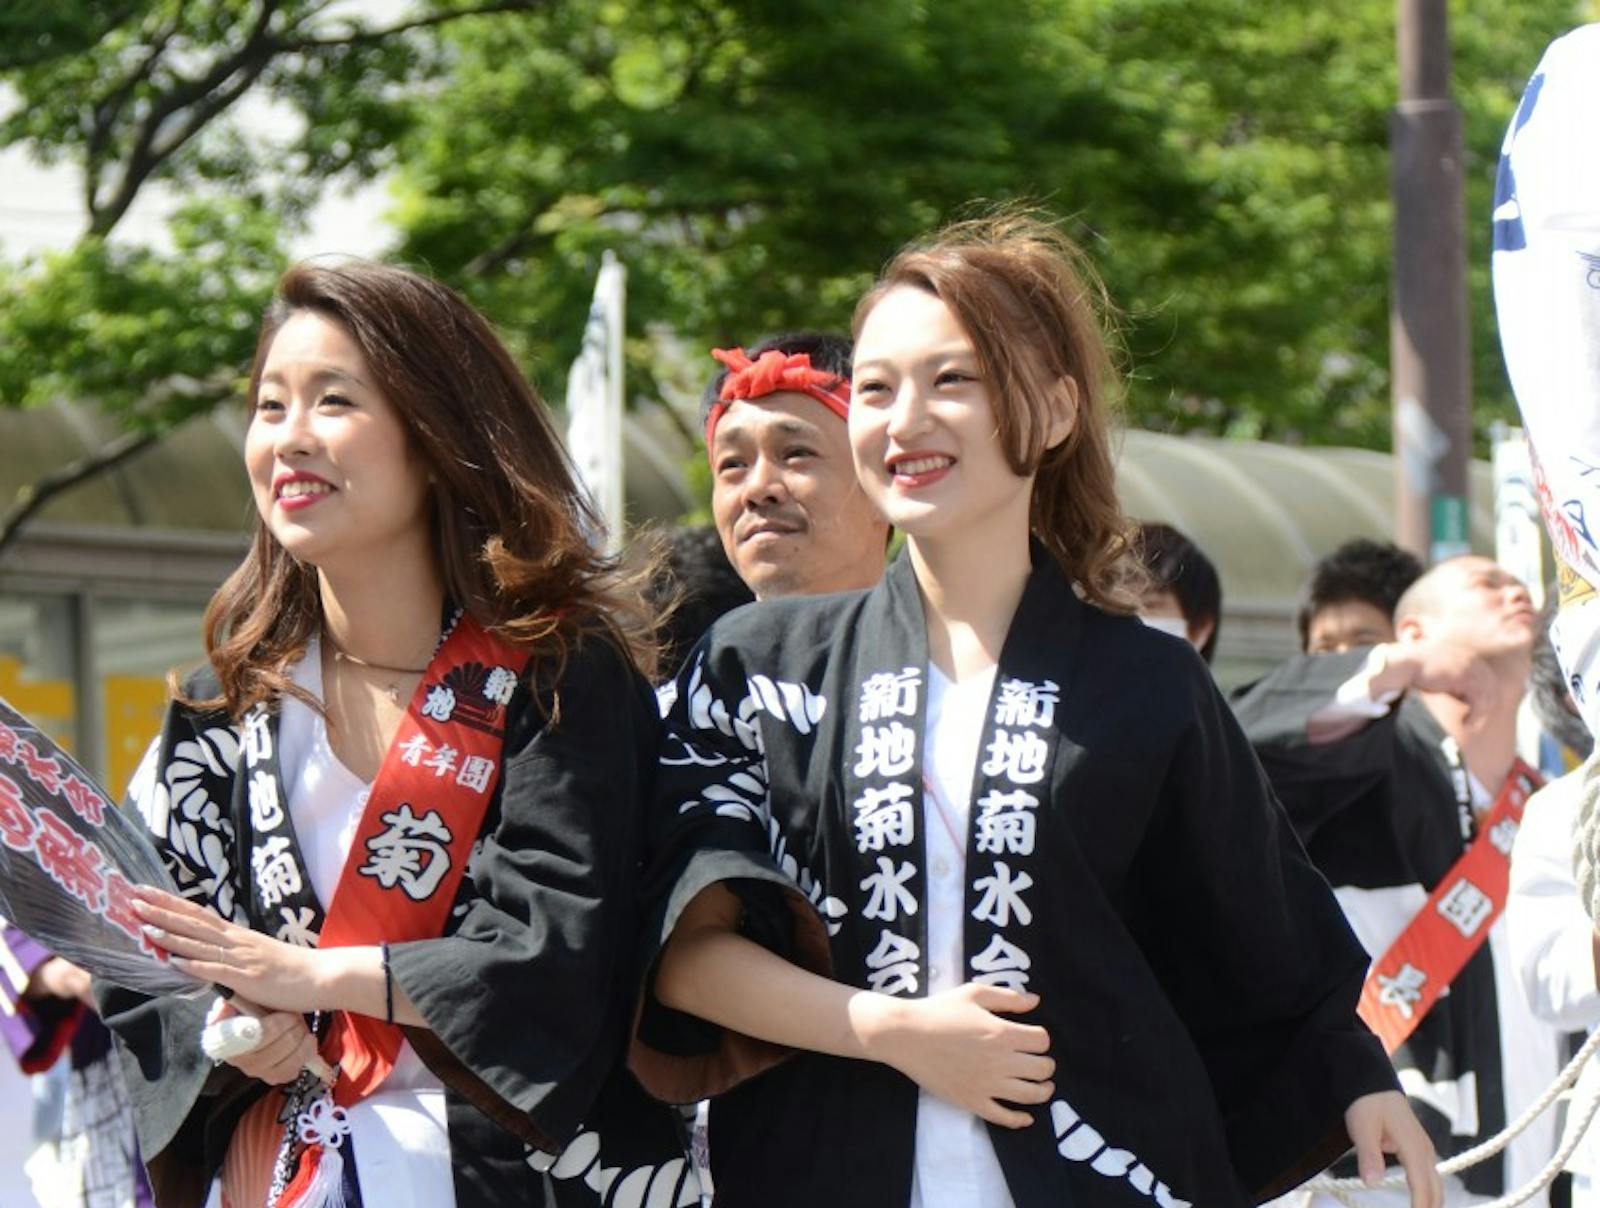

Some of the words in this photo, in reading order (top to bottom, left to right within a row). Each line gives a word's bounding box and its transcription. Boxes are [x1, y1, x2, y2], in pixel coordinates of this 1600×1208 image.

[358, 803, 453, 900] 菊
[853, 667, 921, 996] 新地菊水会
[970, 678, 1060, 994] 新地菊水会
